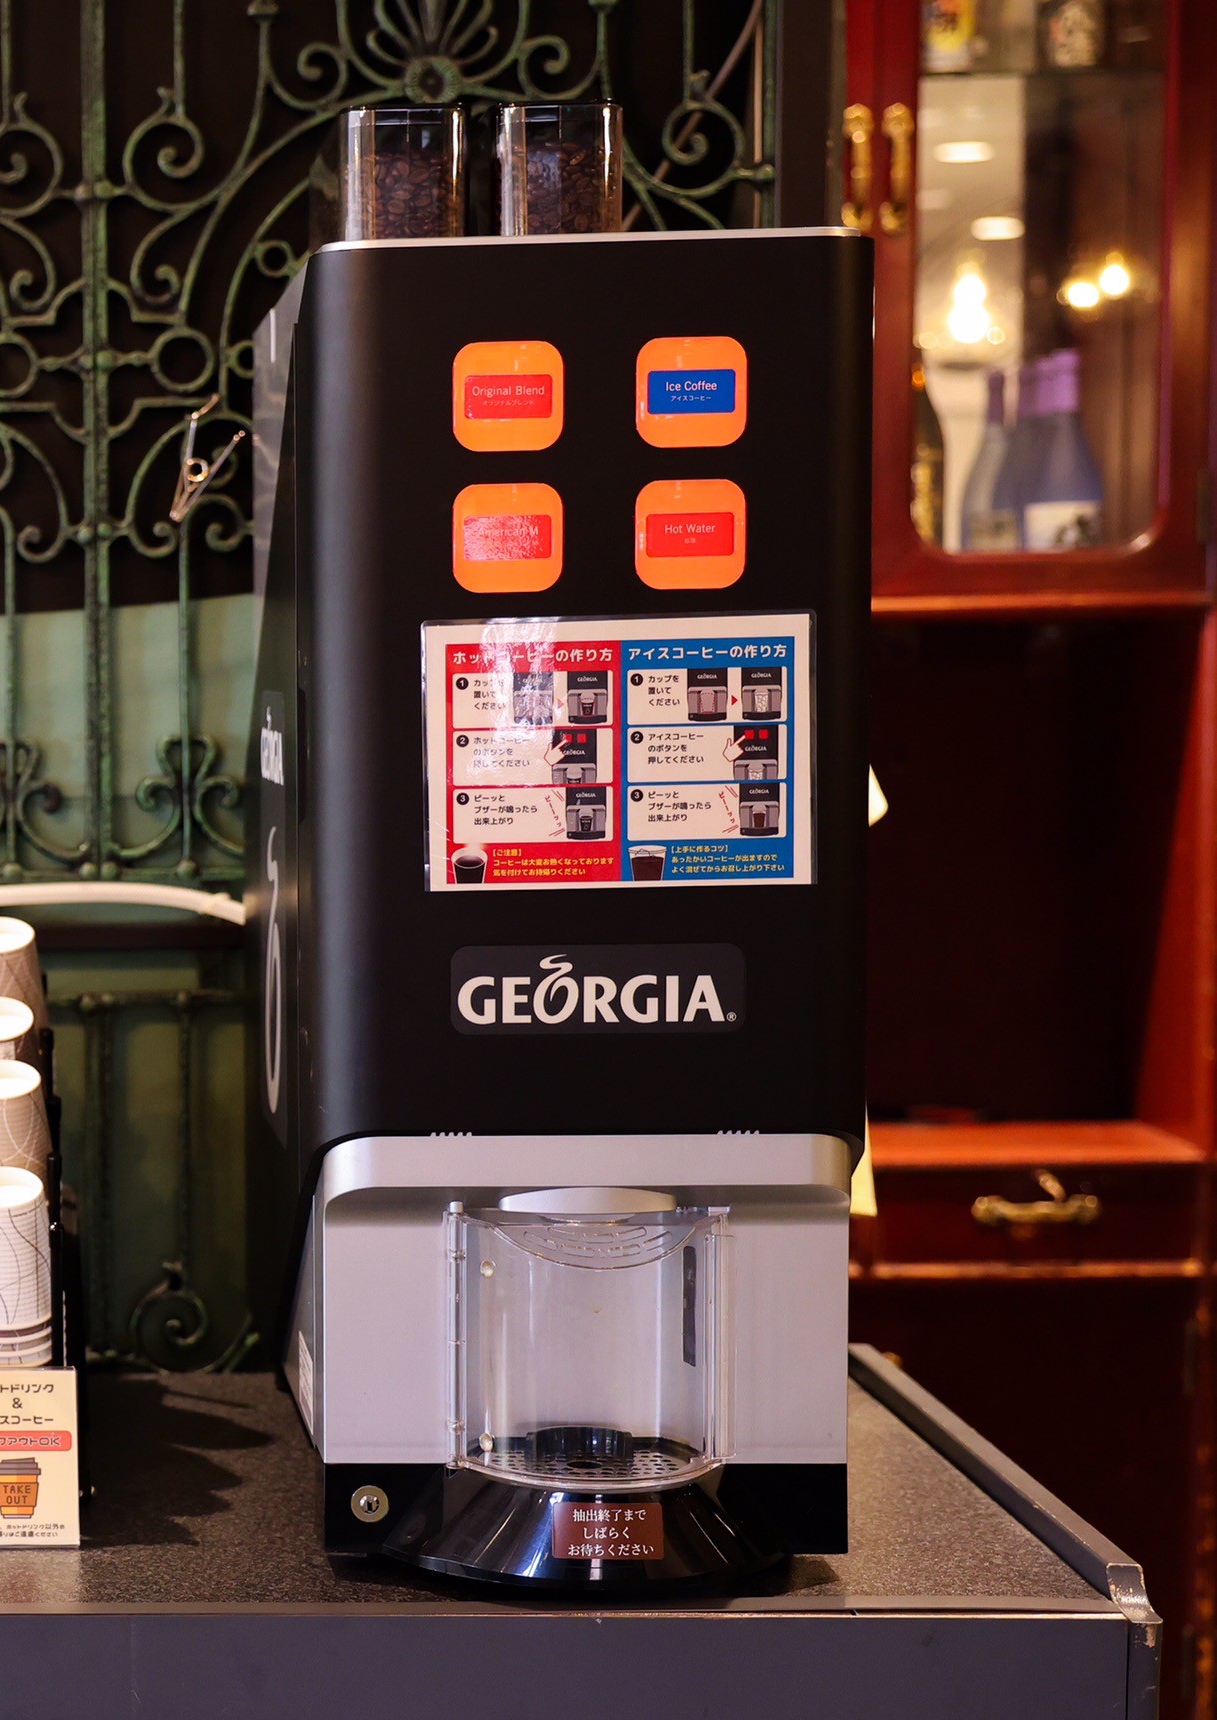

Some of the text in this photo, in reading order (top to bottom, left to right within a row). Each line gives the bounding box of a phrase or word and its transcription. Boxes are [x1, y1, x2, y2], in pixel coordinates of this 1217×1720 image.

[666, 380, 717, 391] Ice Coffee
[472, 385, 545, 398] Original Blend
[664, 524, 716, 534] Hot Water
[628, 644, 787, 661] アイスコーヒーの作り方
[648, 675, 680, 683] カップを
[473, 690, 496, 698] 置いて
[648, 686, 672, 695] 置いて
[474, 701, 505, 710] ください
[648, 698, 681, 706] ください
[474, 737, 531, 745] ホットコーヒー
[648, 733, 704, 741] アイスコーヒー
[648, 755, 704, 764] 押してください
[648, 791, 680, 799] ピーッと
[474, 805, 537, 813] ブザーが鳴ったら
[648, 802, 711, 811] ブザーが鳴ったら
[474, 817, 513, 825] 出来上がり
[648, 814, 688, 822] 出来上がり
[493, 858, 614, 866] コーヒーは大変お熱くなっております
[671, 854, 778, 863] あったかいコーヒーが出ますので
[493, 868, 586, 877] 気を付けてお持帰りください
[671, 864, 785, 874] よく混ぜてからお召し上がり下さい
[12, 1397, 23, 1409] &
[3, 1485, 31, 1494] TAKE
[6, 1495, 28, 1505] OUT
[573, 1508, 646, 1522] 抽出終了まで
[584, 1527, 630, 1539] しばらく
[568, 1543, 654, 1557] お待ちください
